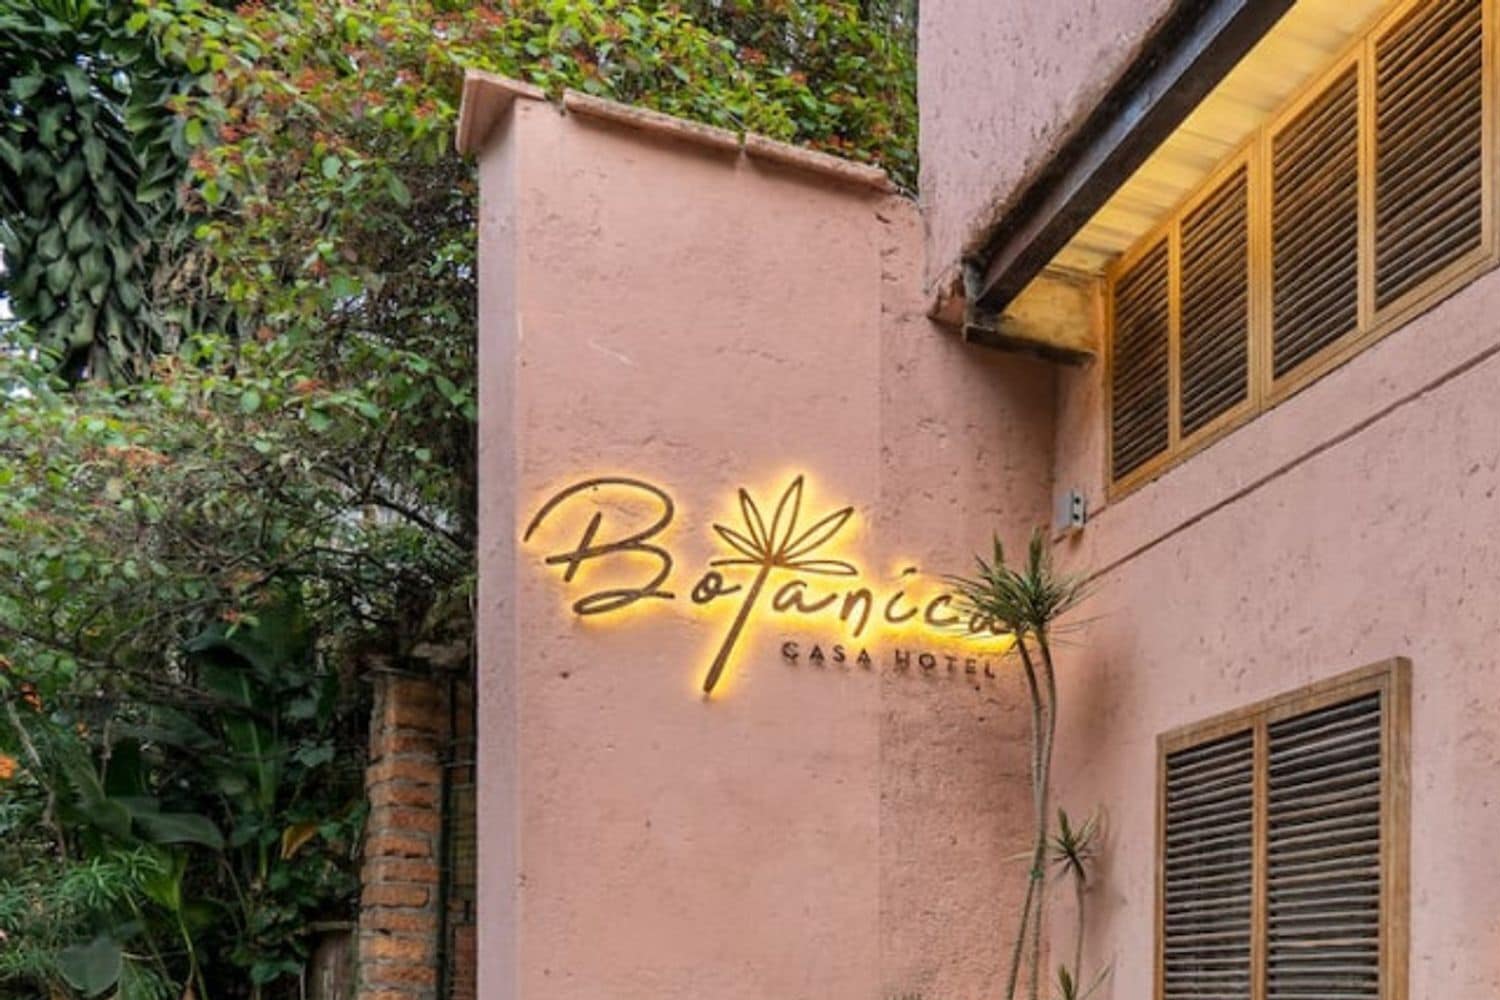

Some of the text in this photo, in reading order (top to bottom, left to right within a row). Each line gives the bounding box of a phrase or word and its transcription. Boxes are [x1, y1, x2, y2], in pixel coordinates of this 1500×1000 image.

[523, 475, 1017, 694] Botanica
[781, 641, 996, 679] CASA HOTEL
